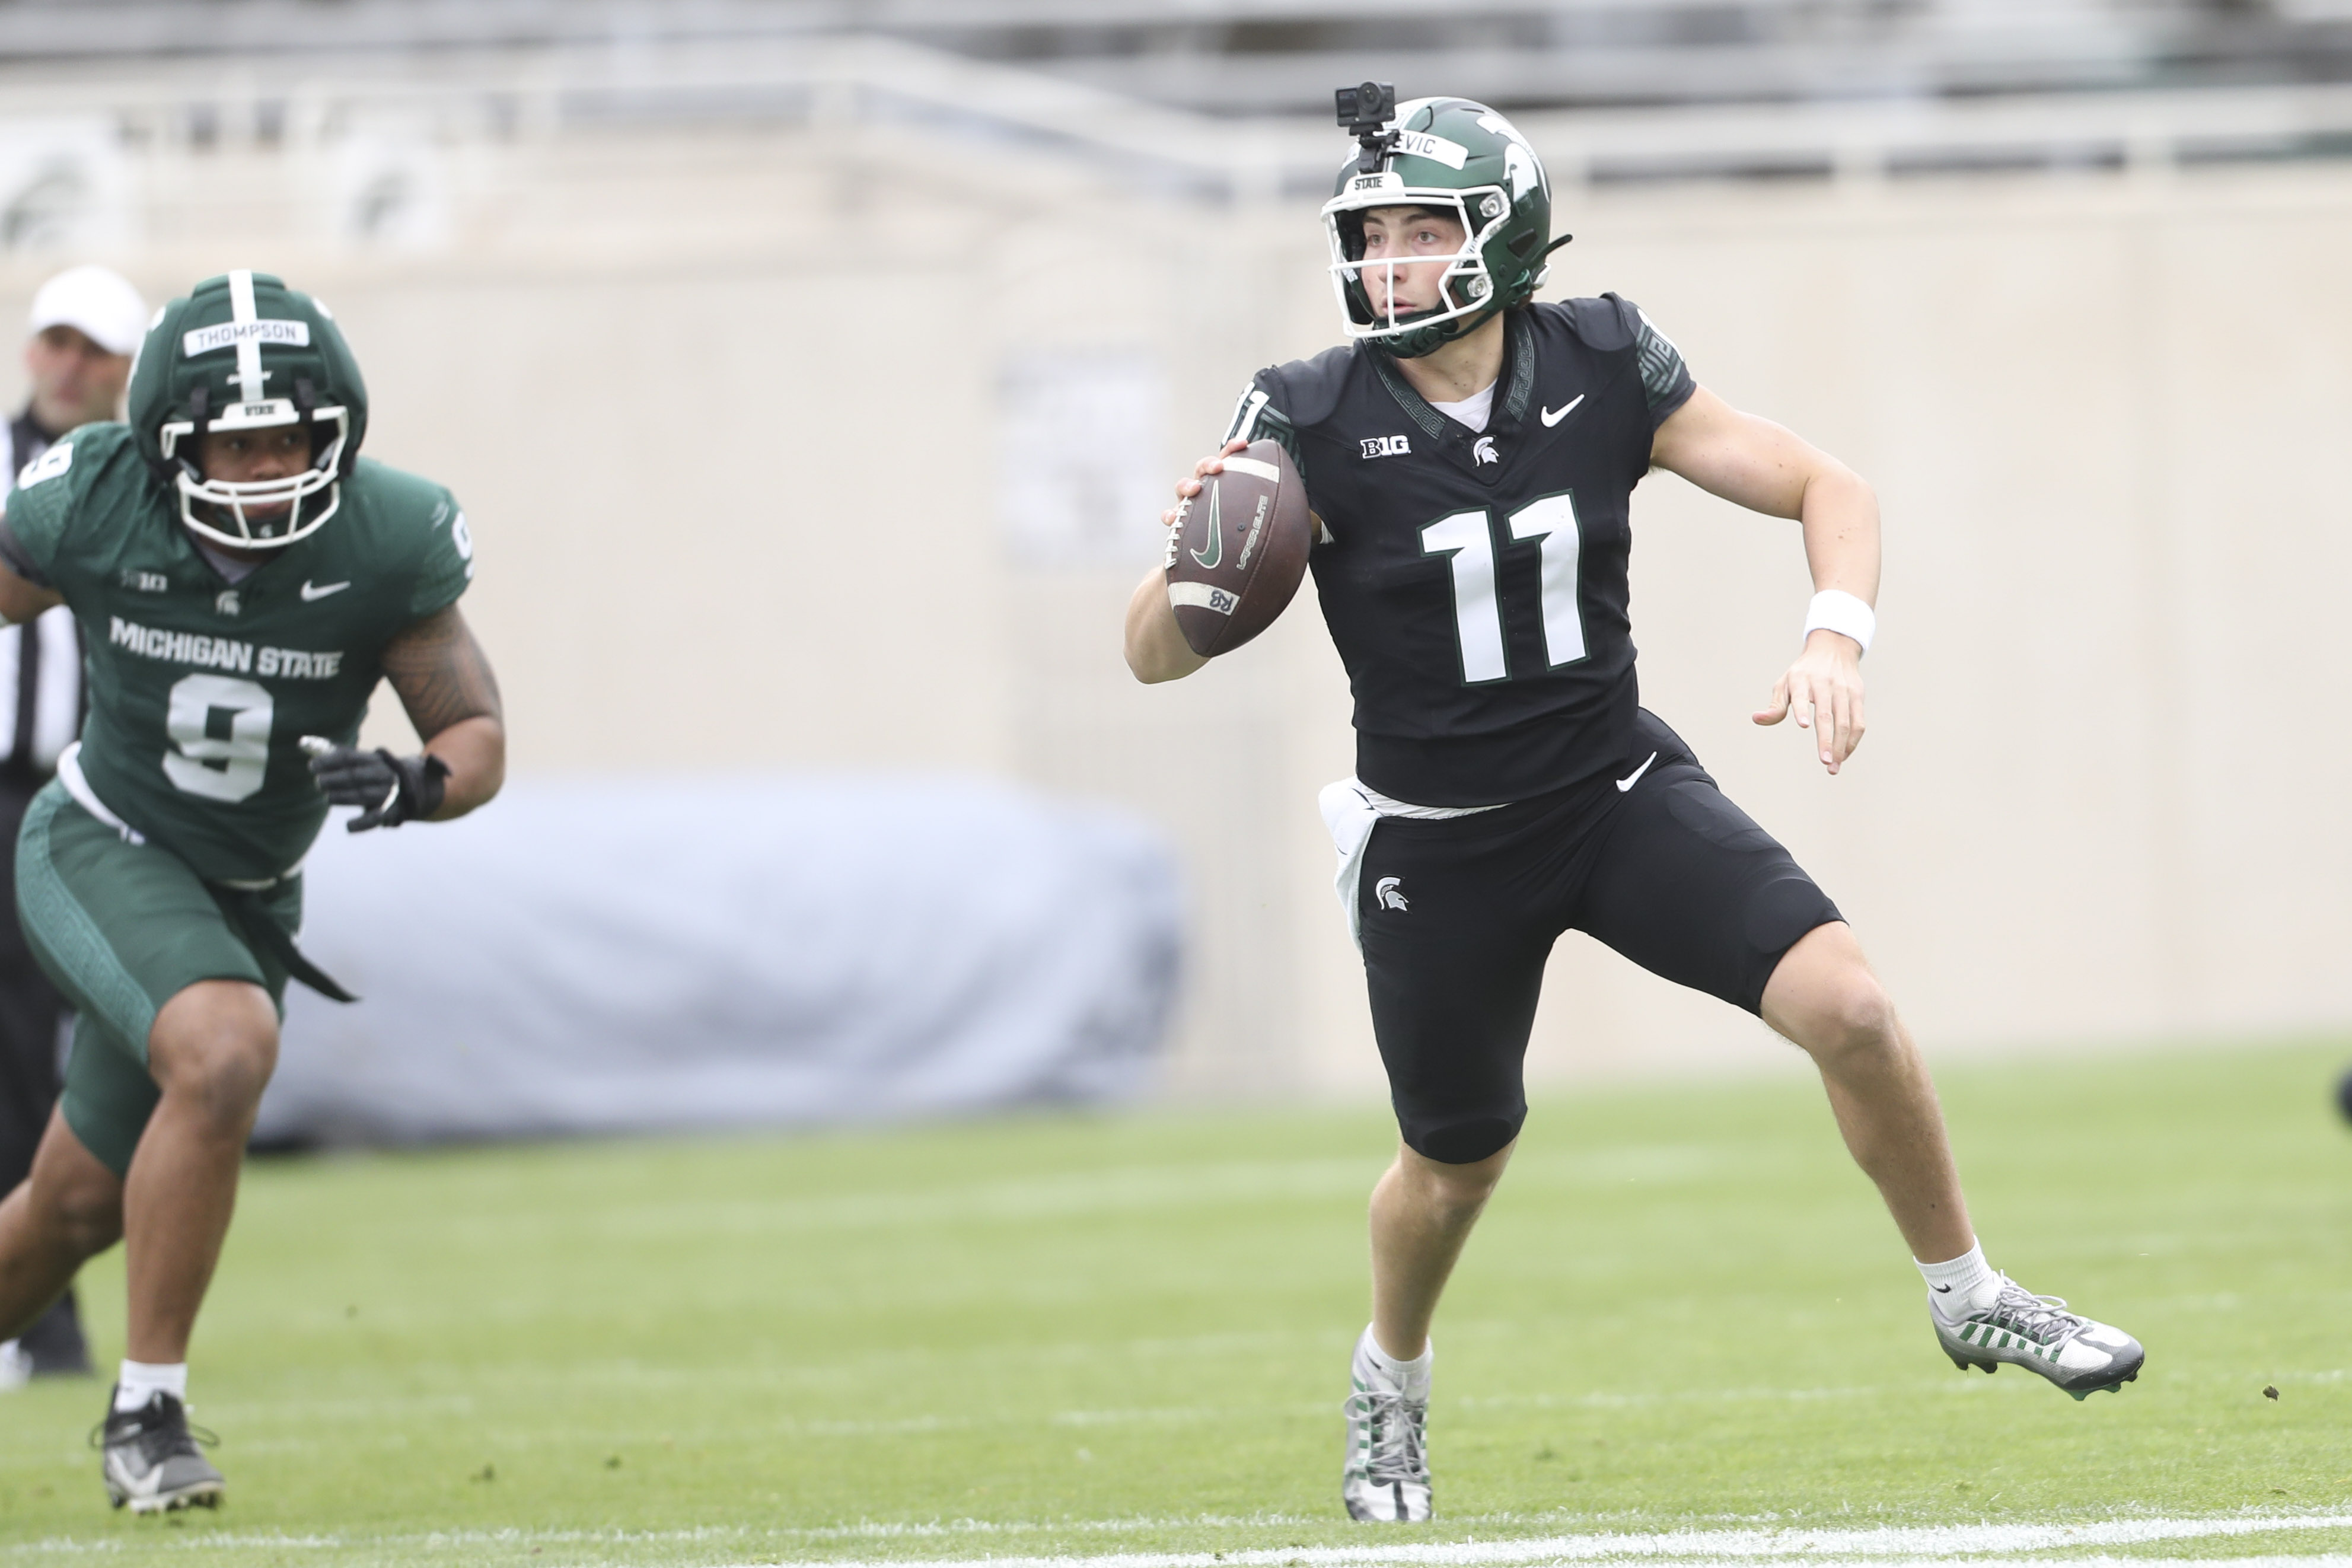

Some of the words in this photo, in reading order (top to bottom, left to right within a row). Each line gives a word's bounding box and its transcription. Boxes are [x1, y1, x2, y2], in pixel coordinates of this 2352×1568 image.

[1354, 176, 1384, 190] STATE
[197, 323, 297, 349] THOMPSON
[1236, 528, 1260, 570] VAPOR
[1253, 495, 1269, 530] ELITE
[1209, 589, 1234, 612] RB
[1418, 489, 1590, 686] 11
[109, 616, 253, 674] MICHIGAN
[256, 646, 345, 680] STATE
[161, 673, 274, 804] 9
